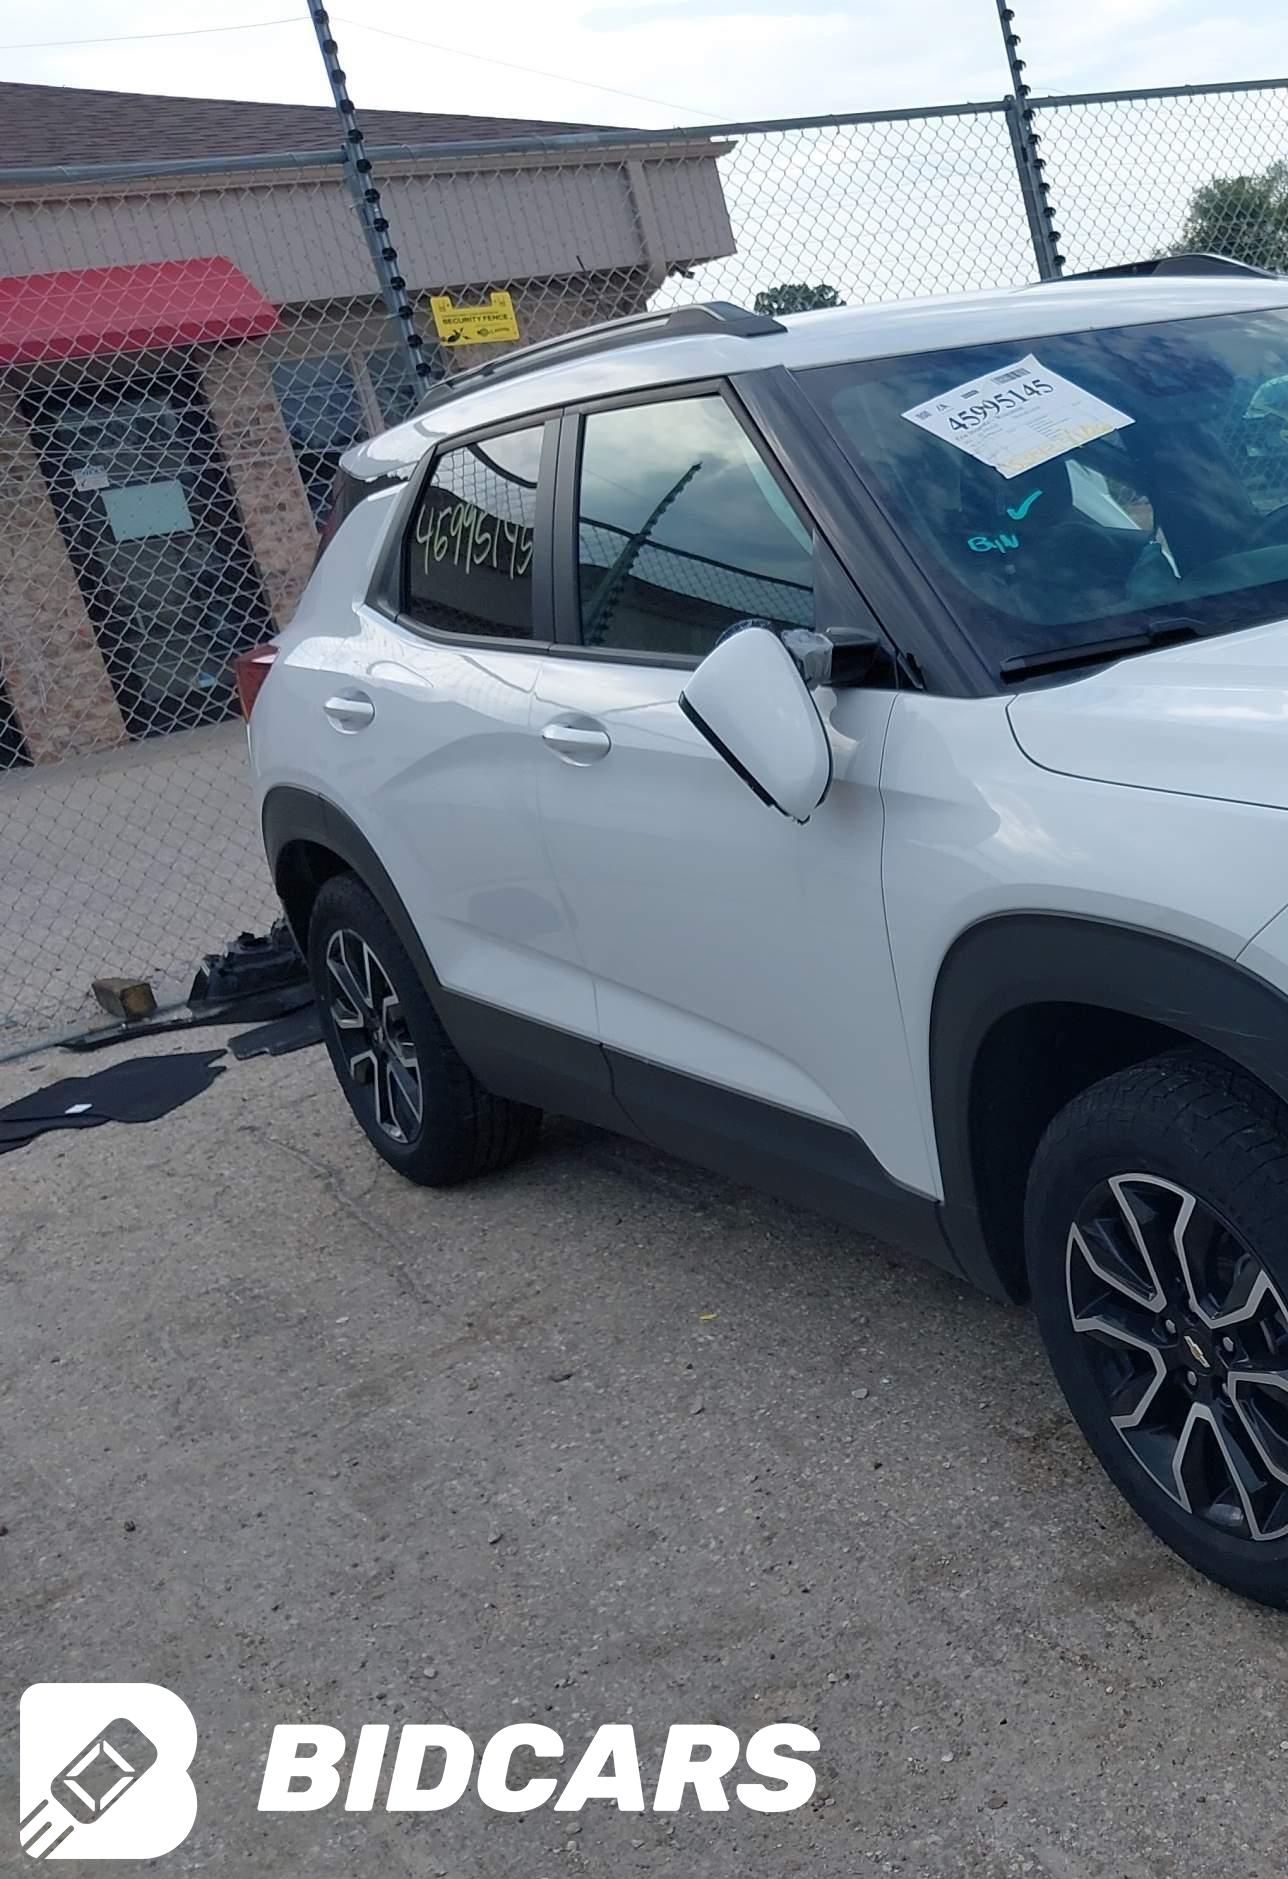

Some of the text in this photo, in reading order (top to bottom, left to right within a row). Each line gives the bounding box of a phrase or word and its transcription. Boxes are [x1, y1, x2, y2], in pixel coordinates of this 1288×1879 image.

[442, 315, 481, 325] SECURITY
[482, 313, 508, 322] FENCE
[948, 378, 1054, 433] 45995145
